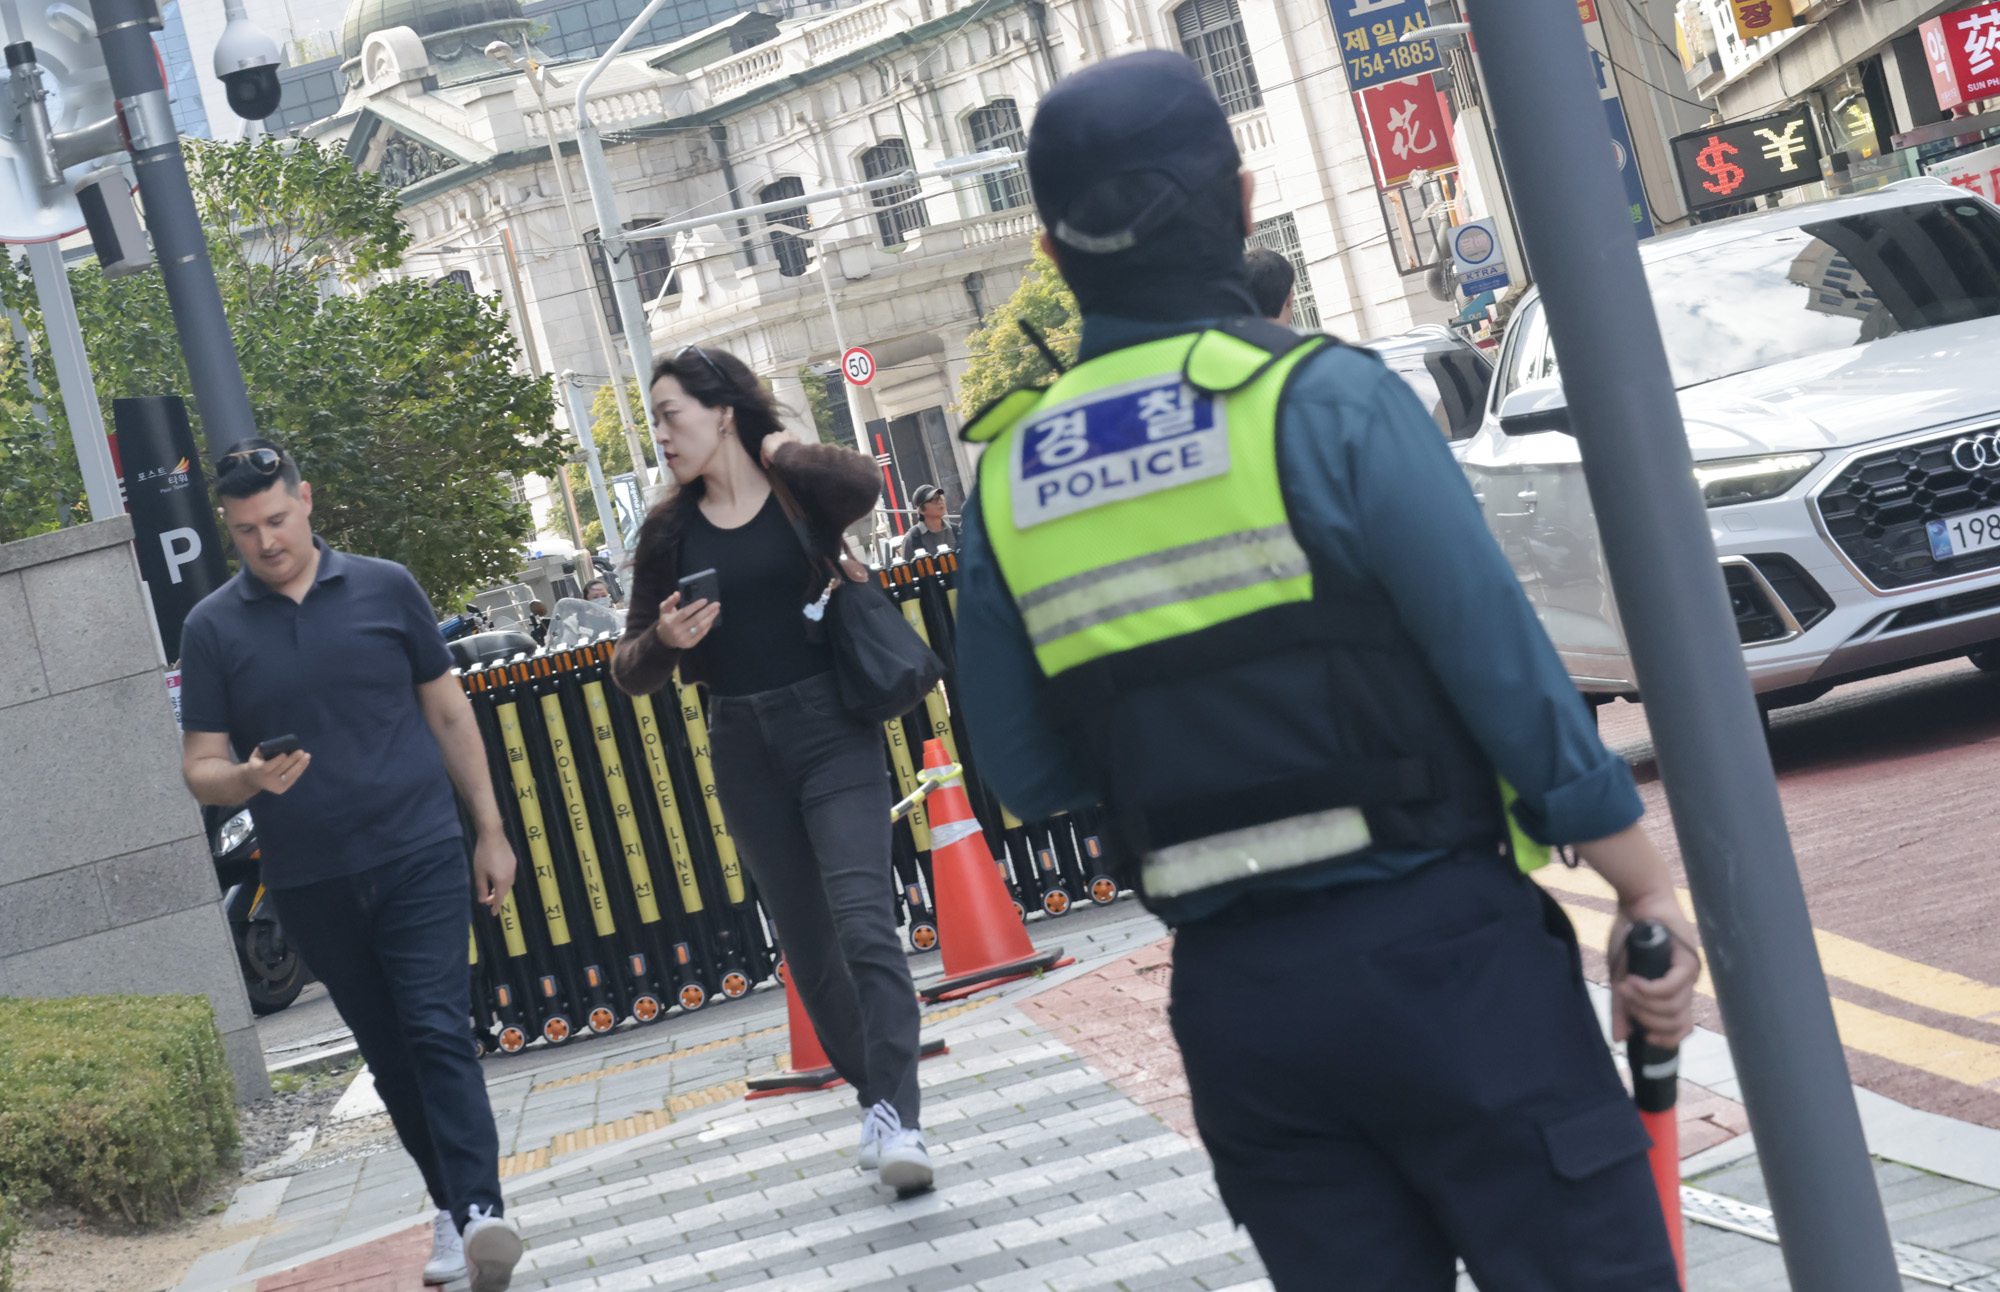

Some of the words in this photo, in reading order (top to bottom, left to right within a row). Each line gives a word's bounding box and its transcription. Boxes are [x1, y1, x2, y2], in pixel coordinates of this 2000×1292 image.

[1735, 0, 1773, 28] 장
[1349, 40, 1435, 80] 754-1885
[1927, 27, 1951, 83] 약
[1967, 81, 1986, 92] SUN
[1387, 99, 1437, 160] 花
[1696, 136, 1745, 195] $
[1753, 119, 1807, 172] ¥
[1466, 267, 1498, 280] KTRA
[849, 356, 869, 377] 50
[1034, 385, 1196, 467] 경찰
[138, 467, 168, 482] 포스트
[168, 473, 189, 484] 타워
[1037, 442, 1203, 507] POLICE
[159, 527, 202, 584] P
[1953, 513, 2000, 548] 198
[596, 725, 651, 898] 질서유지선
[641, 716, 672, 807] POLICE
[669, 827, 691, 887] LINE
[901, 765, 922, 826] LIE
[508, 747, 562, 920] 질서유지선
[554, 739, 585, 831] POLICE
[582, 850, 603, 910] LINE
